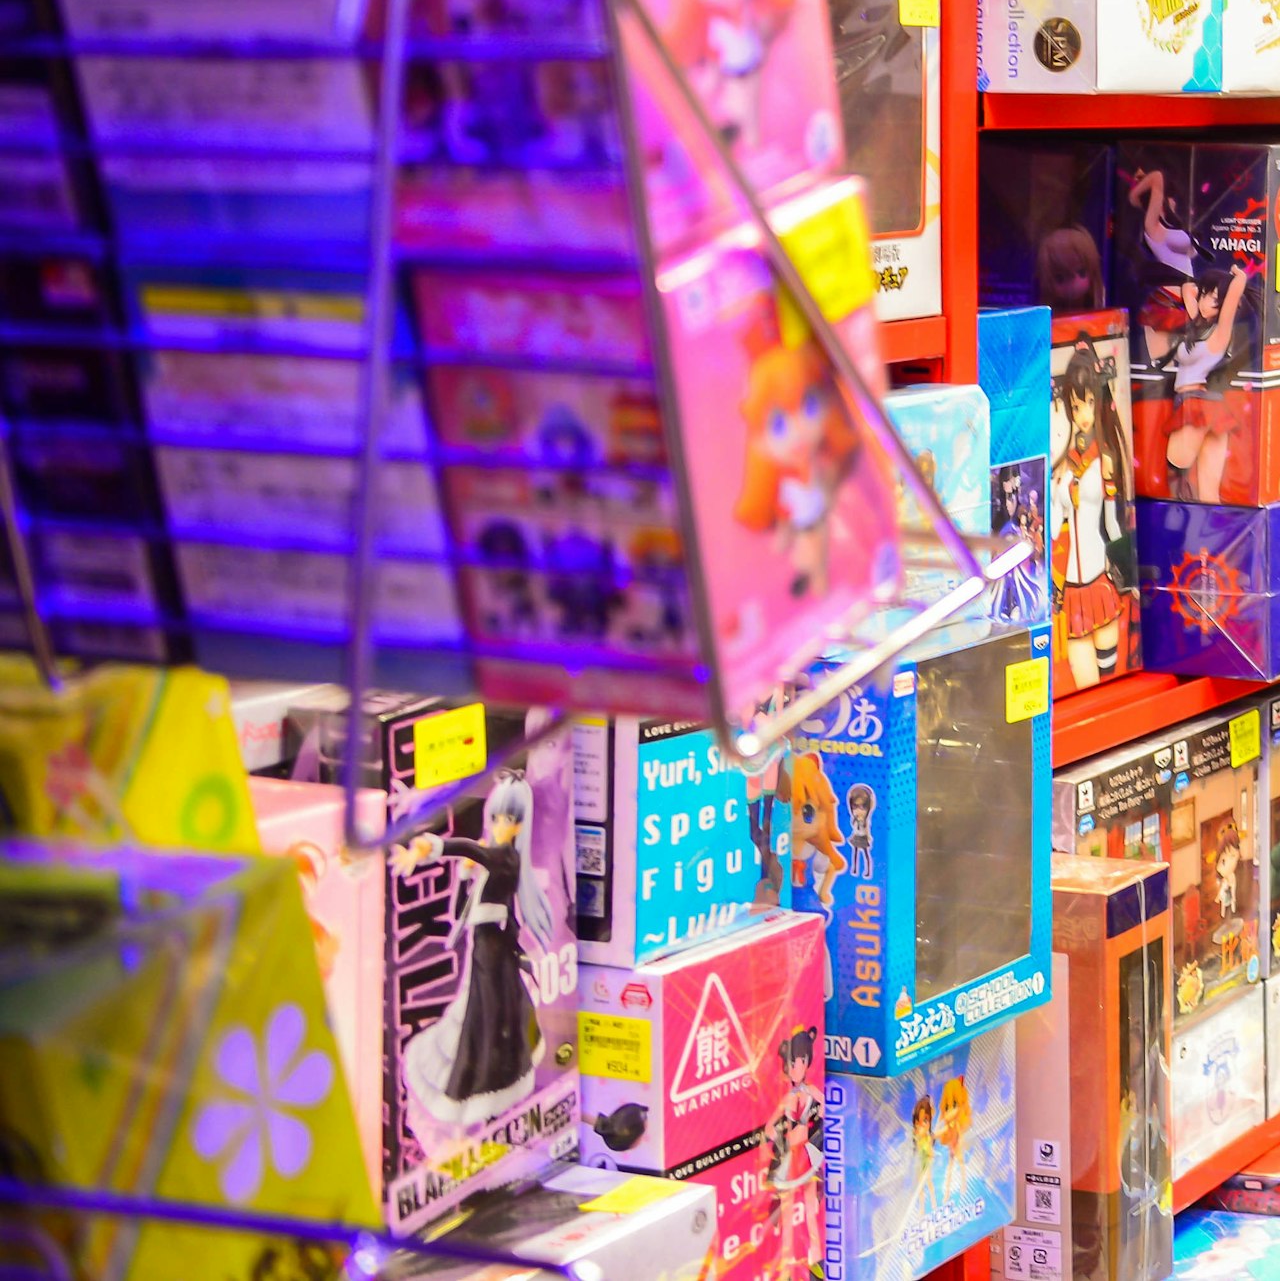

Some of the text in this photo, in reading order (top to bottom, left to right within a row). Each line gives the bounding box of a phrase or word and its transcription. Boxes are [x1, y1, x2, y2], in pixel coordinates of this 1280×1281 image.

[1209, 236, 1262, 253] YAHAGI
[642, 751, 702, 792] Yuri,
[849, 883, 882, 1009] Asuka
[695, 1018, 731, 1080] 熊
[673, 1075, 753, 1119] WARNING
[669, 1163, 695, 1180] LOVE
[695, 1146, 733, 1172] BULLET
[825, 1122, 845, 1281] COLLECTION
